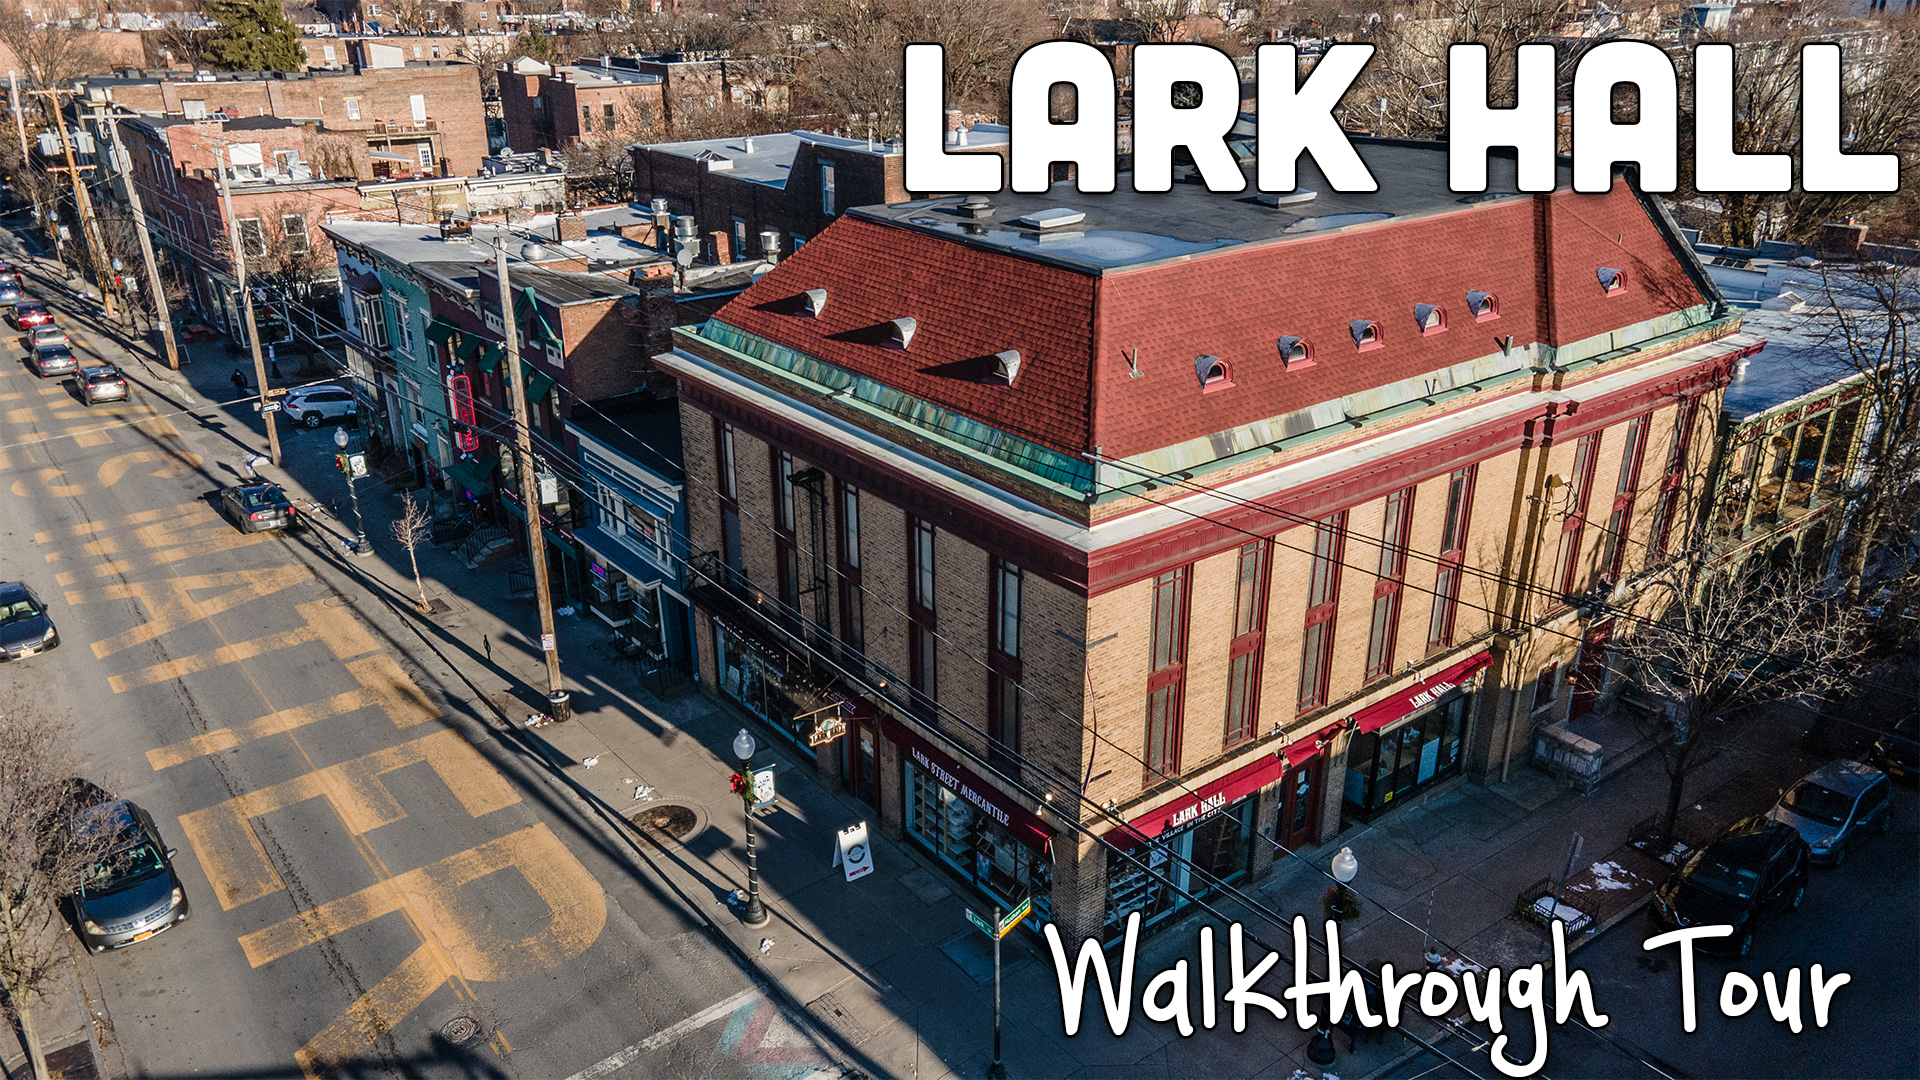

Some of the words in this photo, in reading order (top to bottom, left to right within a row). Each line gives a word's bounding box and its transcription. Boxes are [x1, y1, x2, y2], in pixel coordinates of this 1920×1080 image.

[1408, 690, 1435, 709] LARK
[1429, 681, 1457, 698] HALL
[911, 746, 930, 769] LARK
[930, 762, 960, 791] STREET
[959, 784, 1010, 827] MERCANTILE
[1172, 803, 1199, 827] LARK
[1200, 792, 1226, 813] HALL
[1161, 825, 1184, 840] VILLAGE
